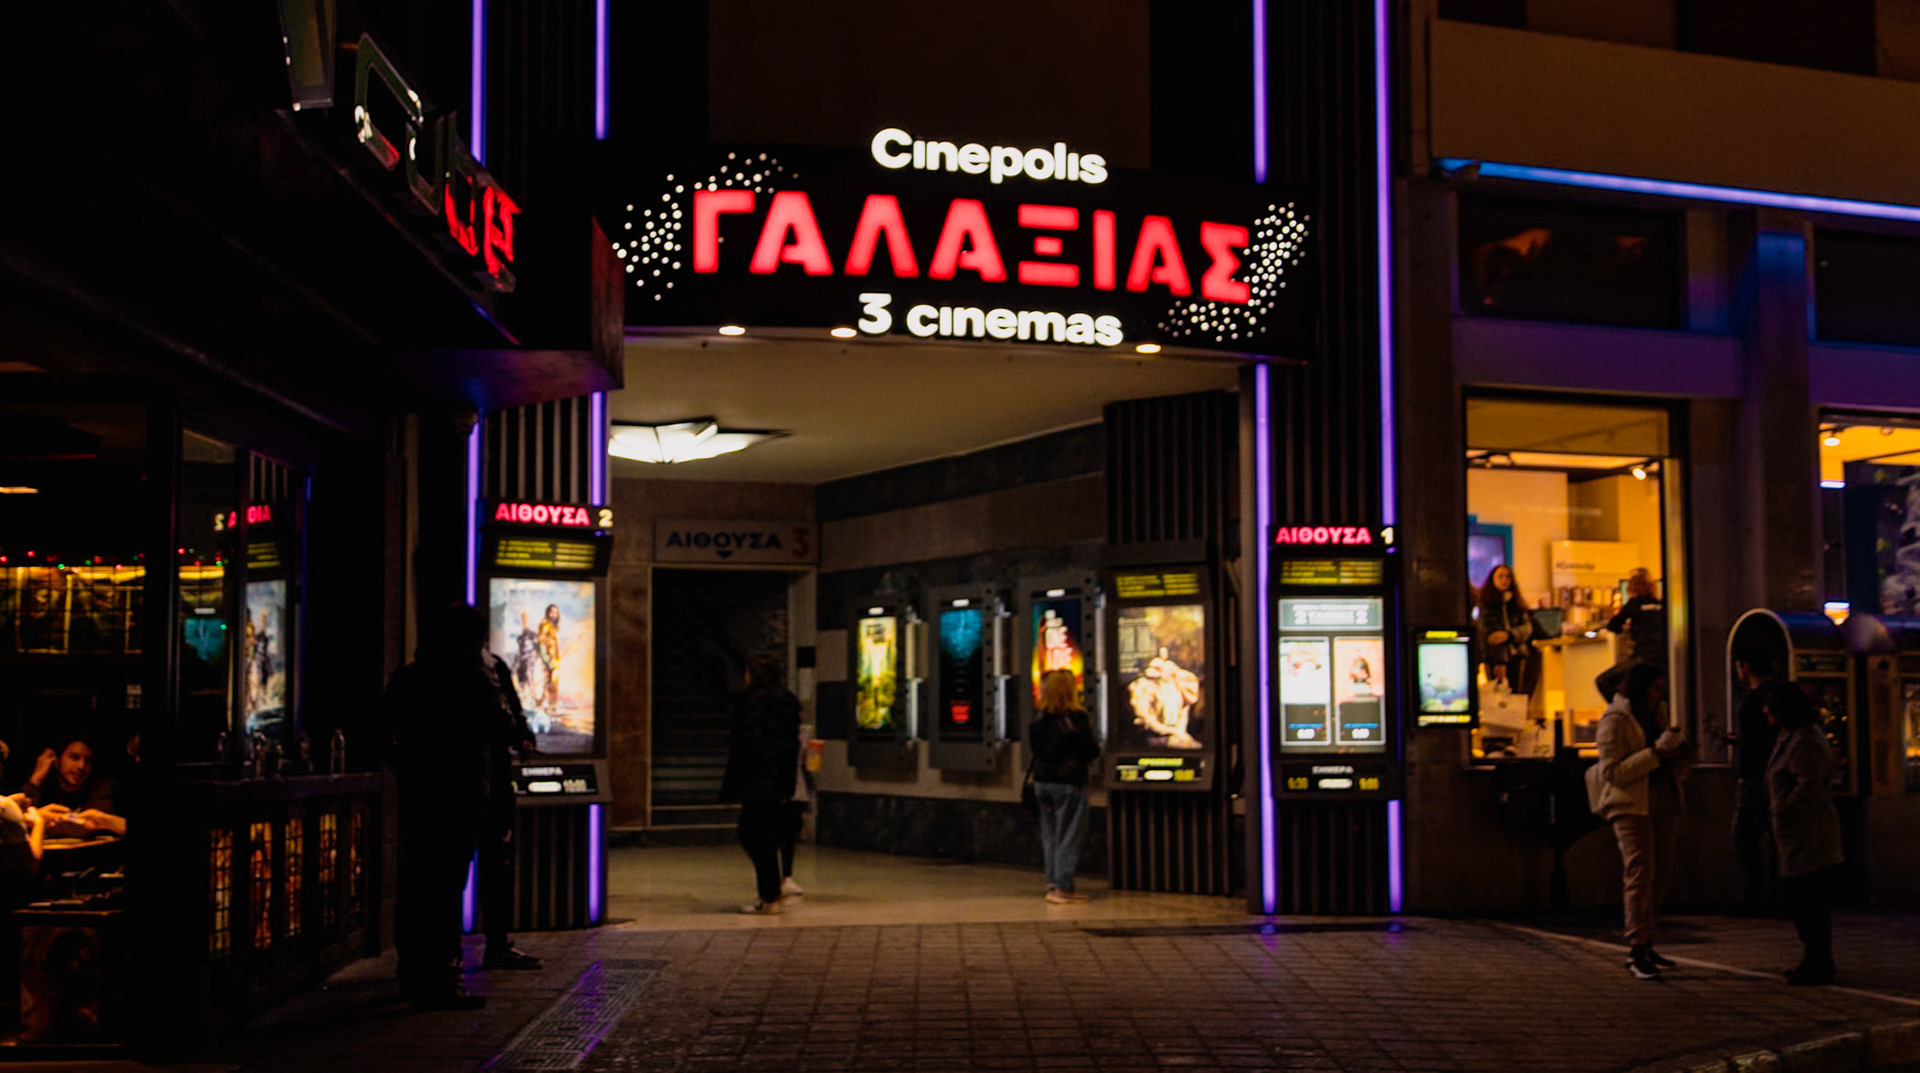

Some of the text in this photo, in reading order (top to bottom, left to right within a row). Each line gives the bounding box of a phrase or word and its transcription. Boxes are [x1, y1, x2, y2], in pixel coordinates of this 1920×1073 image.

[871, 128, 1109, 184] Cinepolis
[692, 188, 1252, 304] ΓΑΛΑΞΙΑΣ
[858, 293, 1124, 347] 3 cinemas
[494, 501, 613, 527] ΑΙΘΟΥΣΑ 2
[666, 528, 810, 558] ΑΙΘΟΥΣΑ 3
[1276, 526, 1394, 545] ΑΙΘΟΥΣΑ 1
